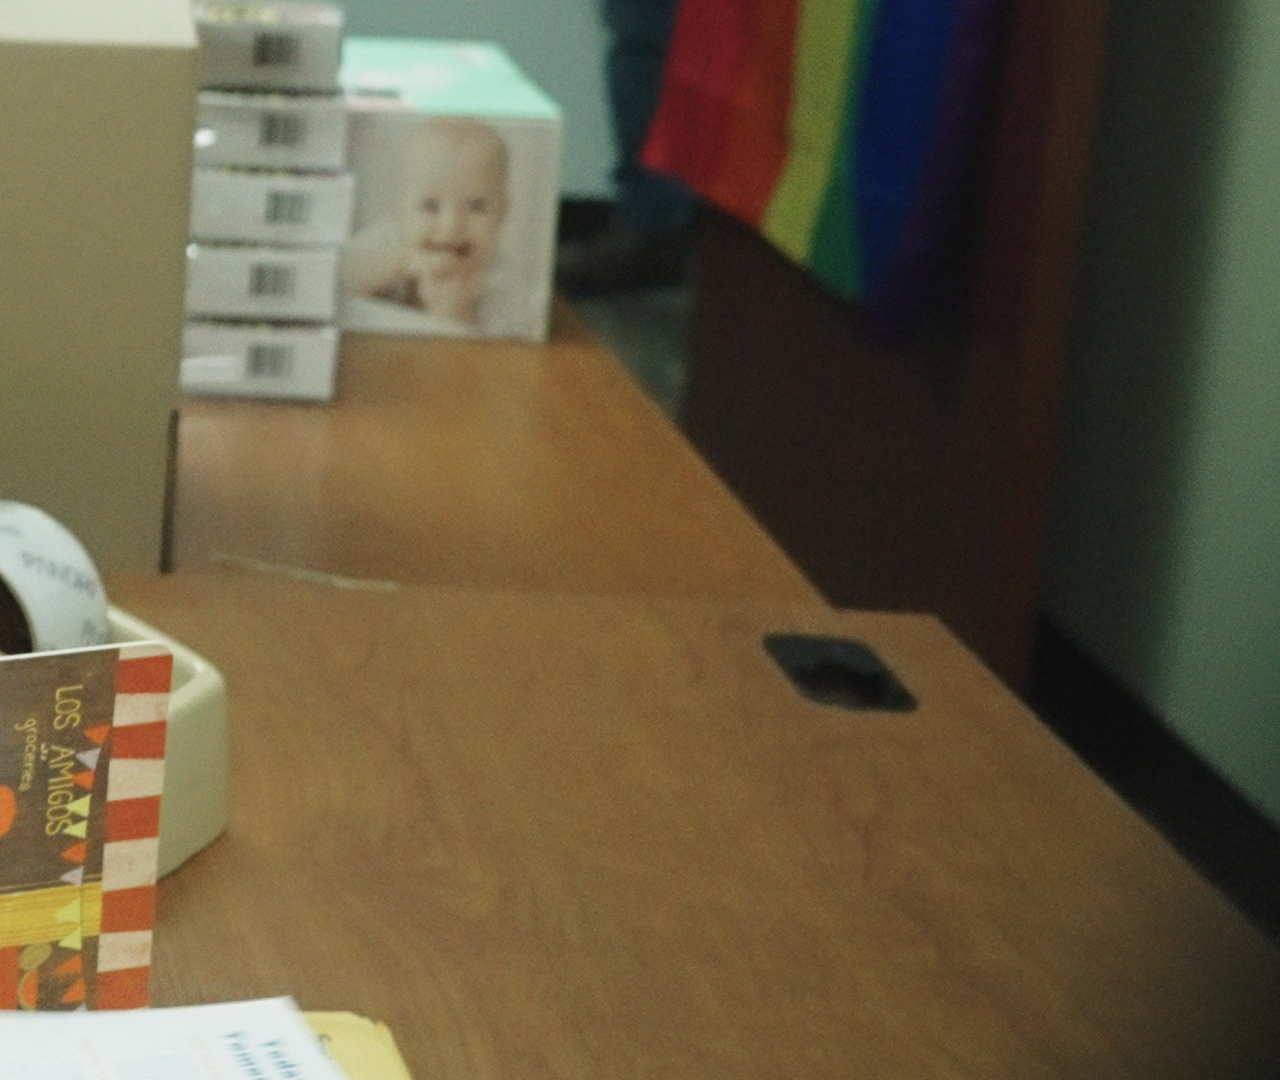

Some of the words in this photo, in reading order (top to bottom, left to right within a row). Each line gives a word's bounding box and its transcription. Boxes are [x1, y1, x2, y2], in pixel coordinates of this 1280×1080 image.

[52, 684, 83, 730] LOS
[14, 717, 37, 792] groceries
[45, 744, 76, 836] AMIGOS
